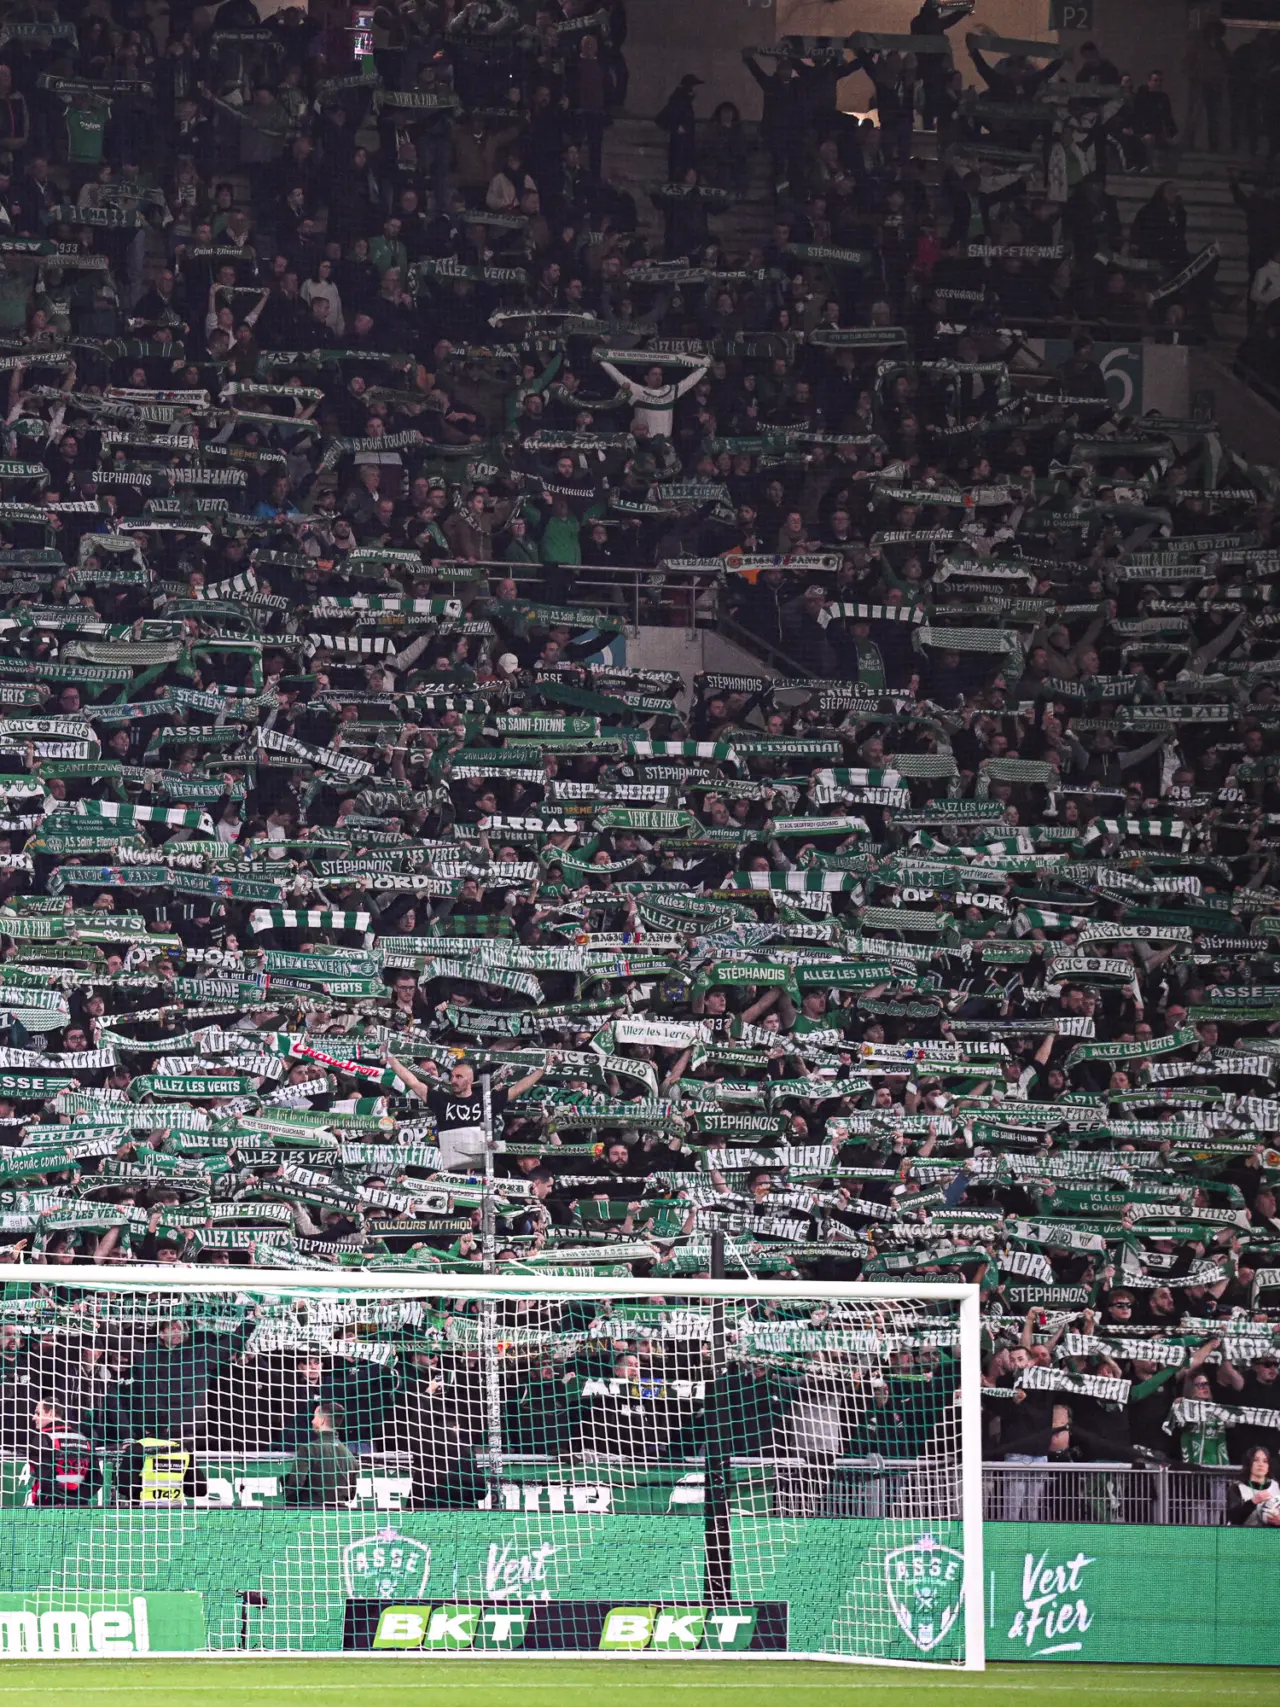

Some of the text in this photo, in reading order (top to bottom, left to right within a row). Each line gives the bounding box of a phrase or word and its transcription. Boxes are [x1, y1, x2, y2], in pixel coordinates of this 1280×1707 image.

[1063, 6, 1088, 28] P2
[241, 384, 323, 398] LES VERTS
[641, 697, 671, 709] VERTS
[162, 726, 214, 736] ASSE
[627, 811, 680, 828] VERT & FIER
[117, 845, 165, 866] Magic
[429, 847, 459, 861] VERTS
[639, 906, 732, 933] ALLEZ LES VERTS
[266, 950, 351, 975] ALLEZ LES VERTS
[718, 964, 786, 981] STÉPHANOIS
[803, 966, 891, 981] ALLEZ LES VERTS
[329, 982, 362, 993] VERTS
[1211, 985, 1263, 998] ASSE
[1092, 1036, 1175, 1057] ALLEZ LES VERTS
[293, 1042, 379, 1079] Chaudron
[154, 1079, 241, 1092] ALLEZ LES VERTS
[445, 1102, 482, 1121] KQS
[179, 1134, 261, 1149] ALLEZ LES VERTS
[237, 1152, 305, 1165] ALLEZ LES
[778, 1145, 834, 1167] NORD
[372, 1219, 426, 1231] TOUJOURS
[231, 1230, 251, 1248] LES
[253, 1228, 290, 1246] VERTS
[1010, 1285, 1089, 1304] STÉPHANOIS
[356, 1549, 418, 1571] ASSE
[486, 1540, 562, 1590] Vert
[896, 1558, 960, 1581] ASSE
[1021, 1549, 1096, 1601] Vert
[378, 1614, 526, 1640] BKT
[606, 1615, 752, 1643] BKT
